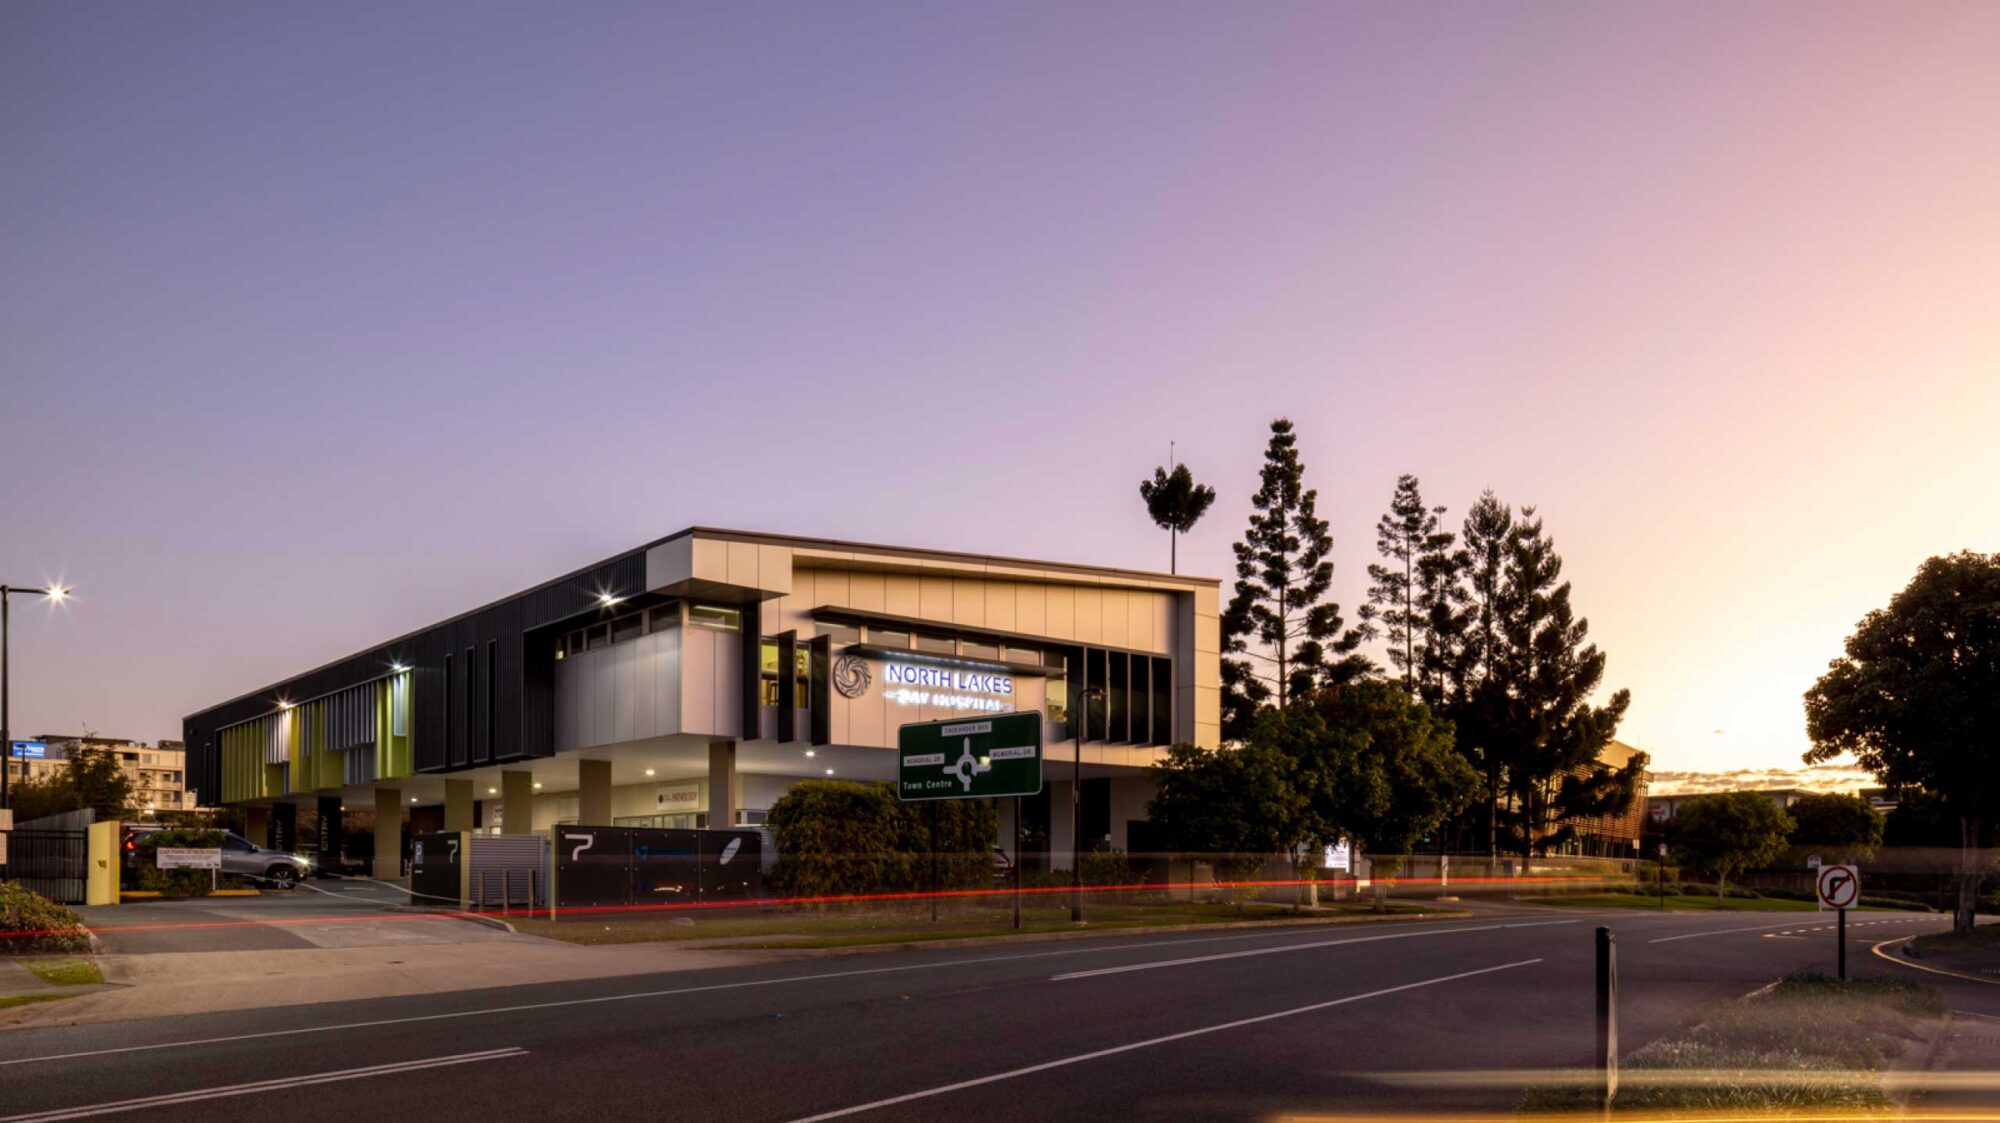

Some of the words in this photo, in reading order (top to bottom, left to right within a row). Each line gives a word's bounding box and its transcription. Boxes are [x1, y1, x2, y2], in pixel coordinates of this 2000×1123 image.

[889, 665, 951, 687] NORTH
[958, 672, 1012, 694] LAKES
[932, 693, 1000, 711] HOSPITAL
[907, 756, 933, 764] MEMORIAL
[934, 755, 941, 763] DR
[993, 749, 1021, 757] MEMORIAL
[1022, 748, 1032, 756] DR
[903, 781, 923, 791] Town
[926, 780, 953, 789] Centre
[671, 791, 698, 803] PATHOLOGY
[320, 815, 329, 852] ENTRY
[447, 839, 459, 864] 7
[564, 833, 594, 861] 7
